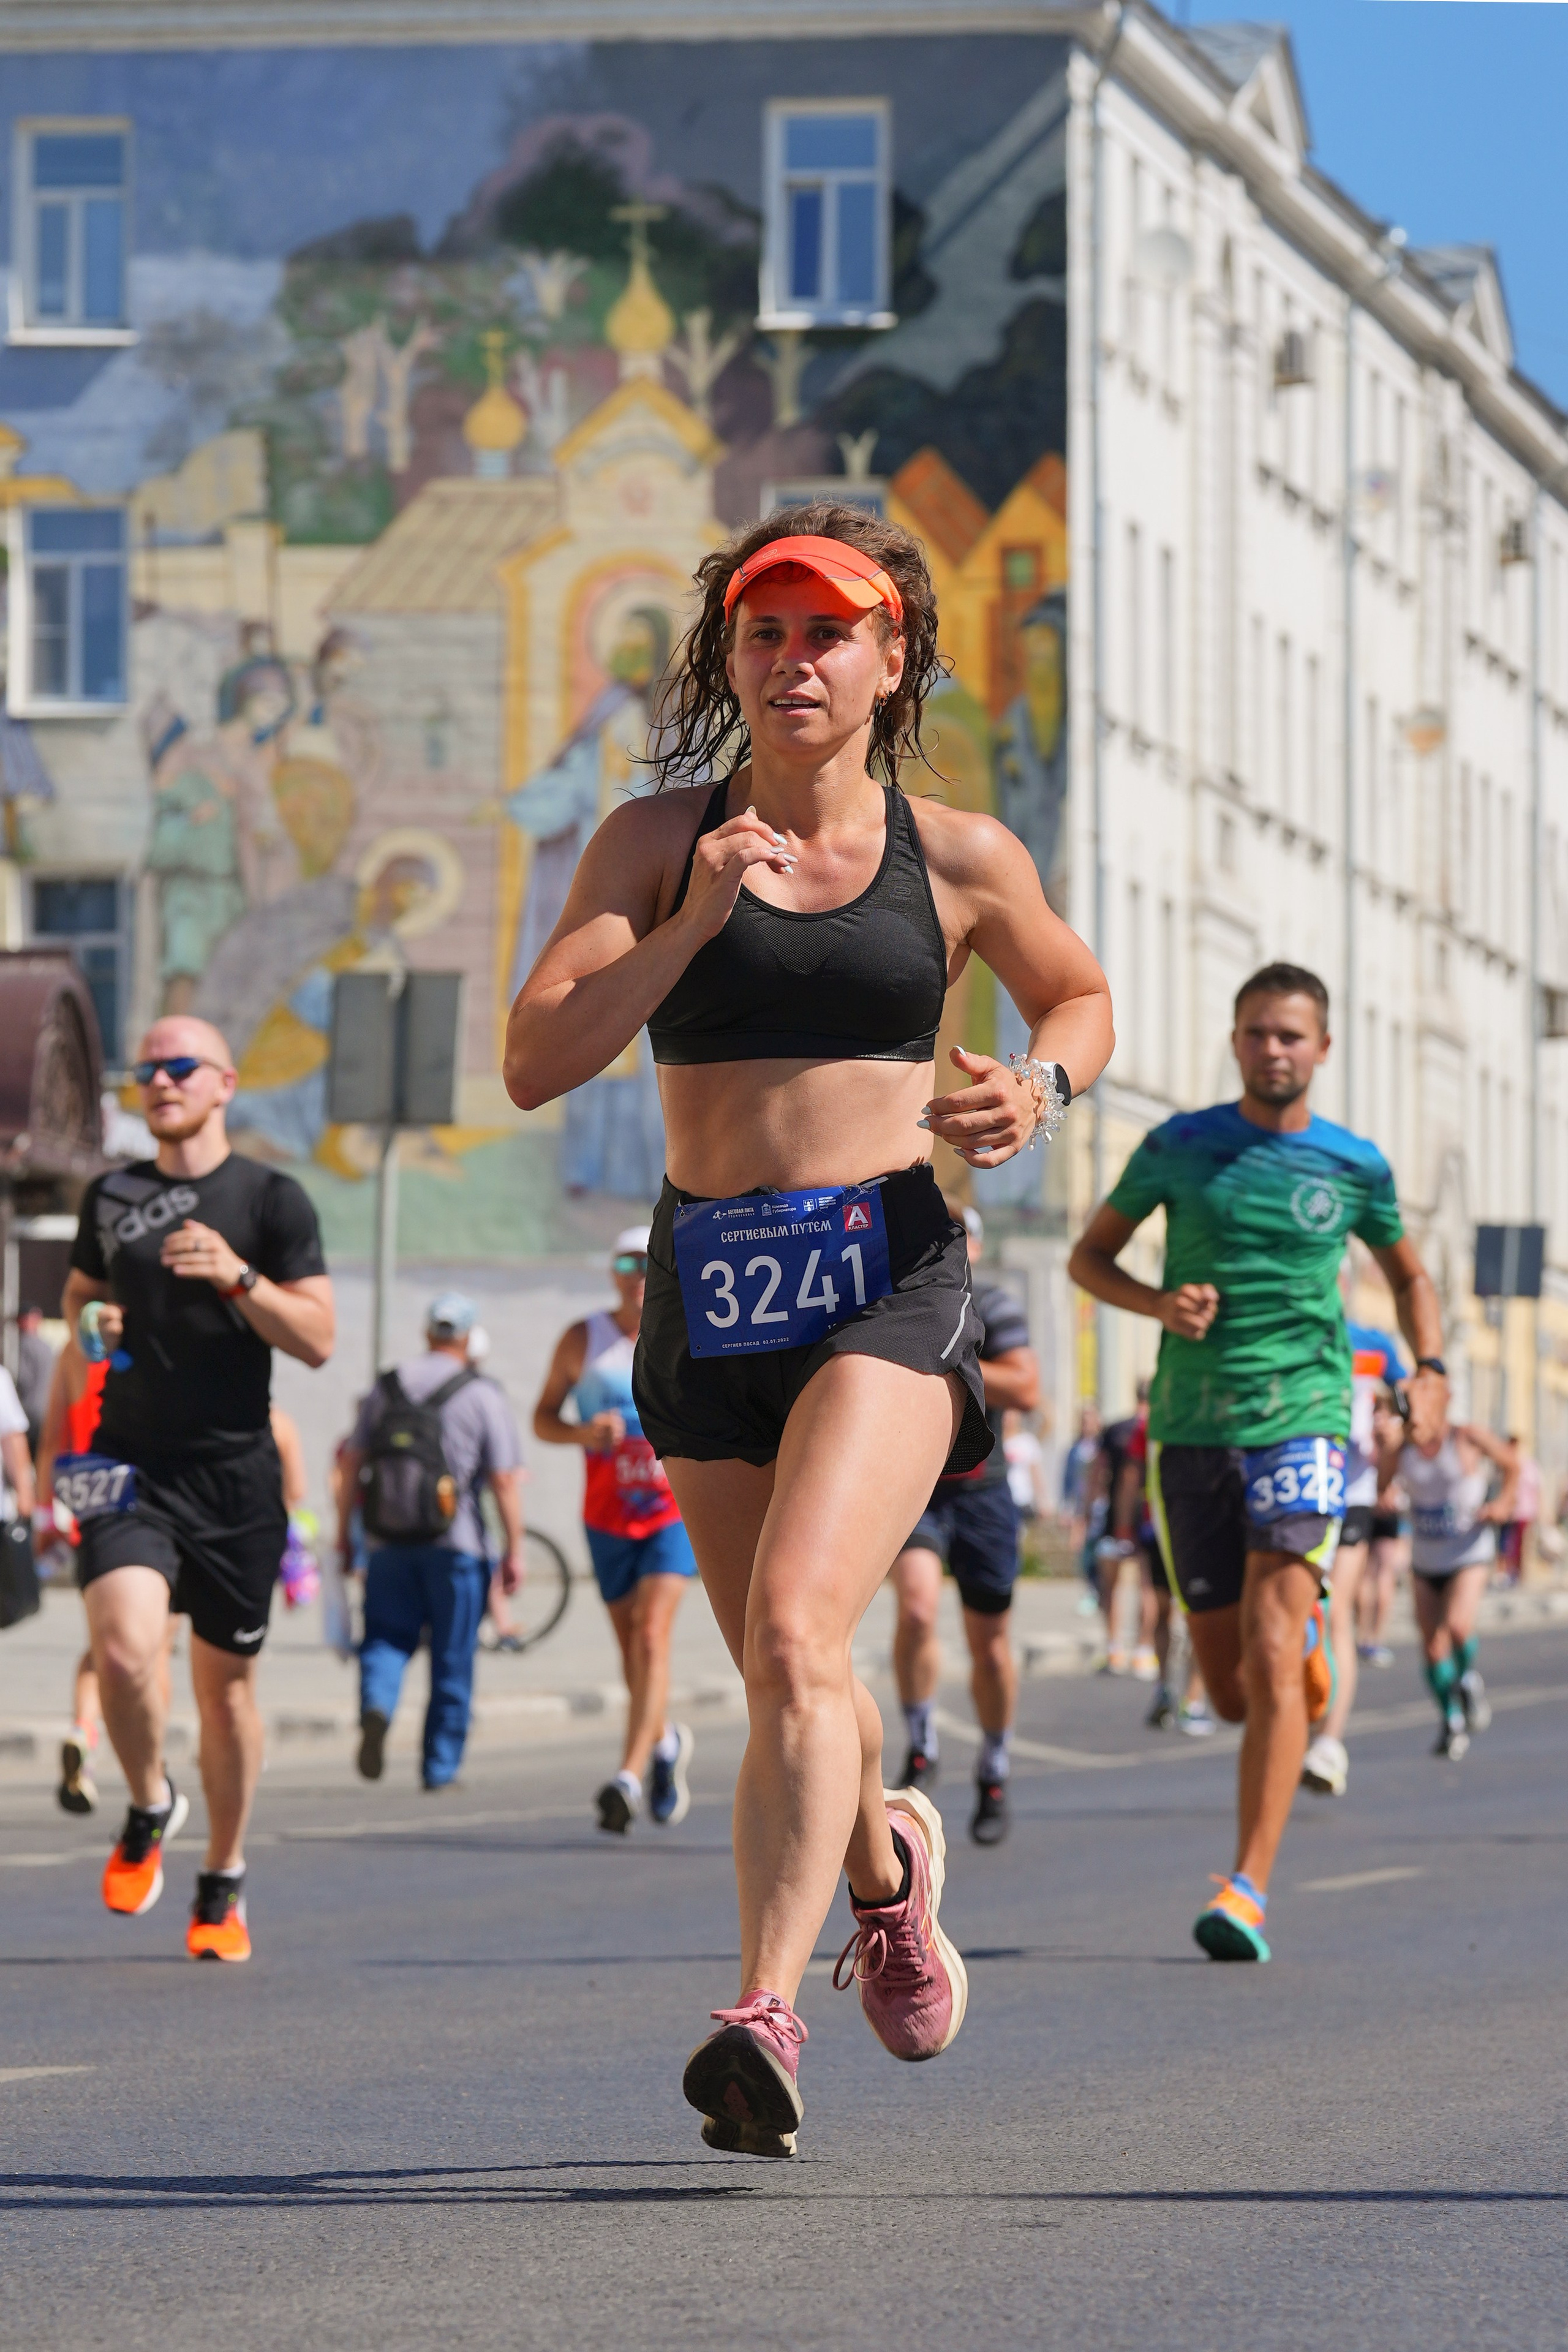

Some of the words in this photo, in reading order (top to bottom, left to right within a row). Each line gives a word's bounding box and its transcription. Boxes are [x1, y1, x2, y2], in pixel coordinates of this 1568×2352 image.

[721, 1225, 789, 1243] СЕРГИЕВЫМ
[791, 1219, 832, 1235] ПУТЕМ
[701, 1243, 867, 1329] 3241
